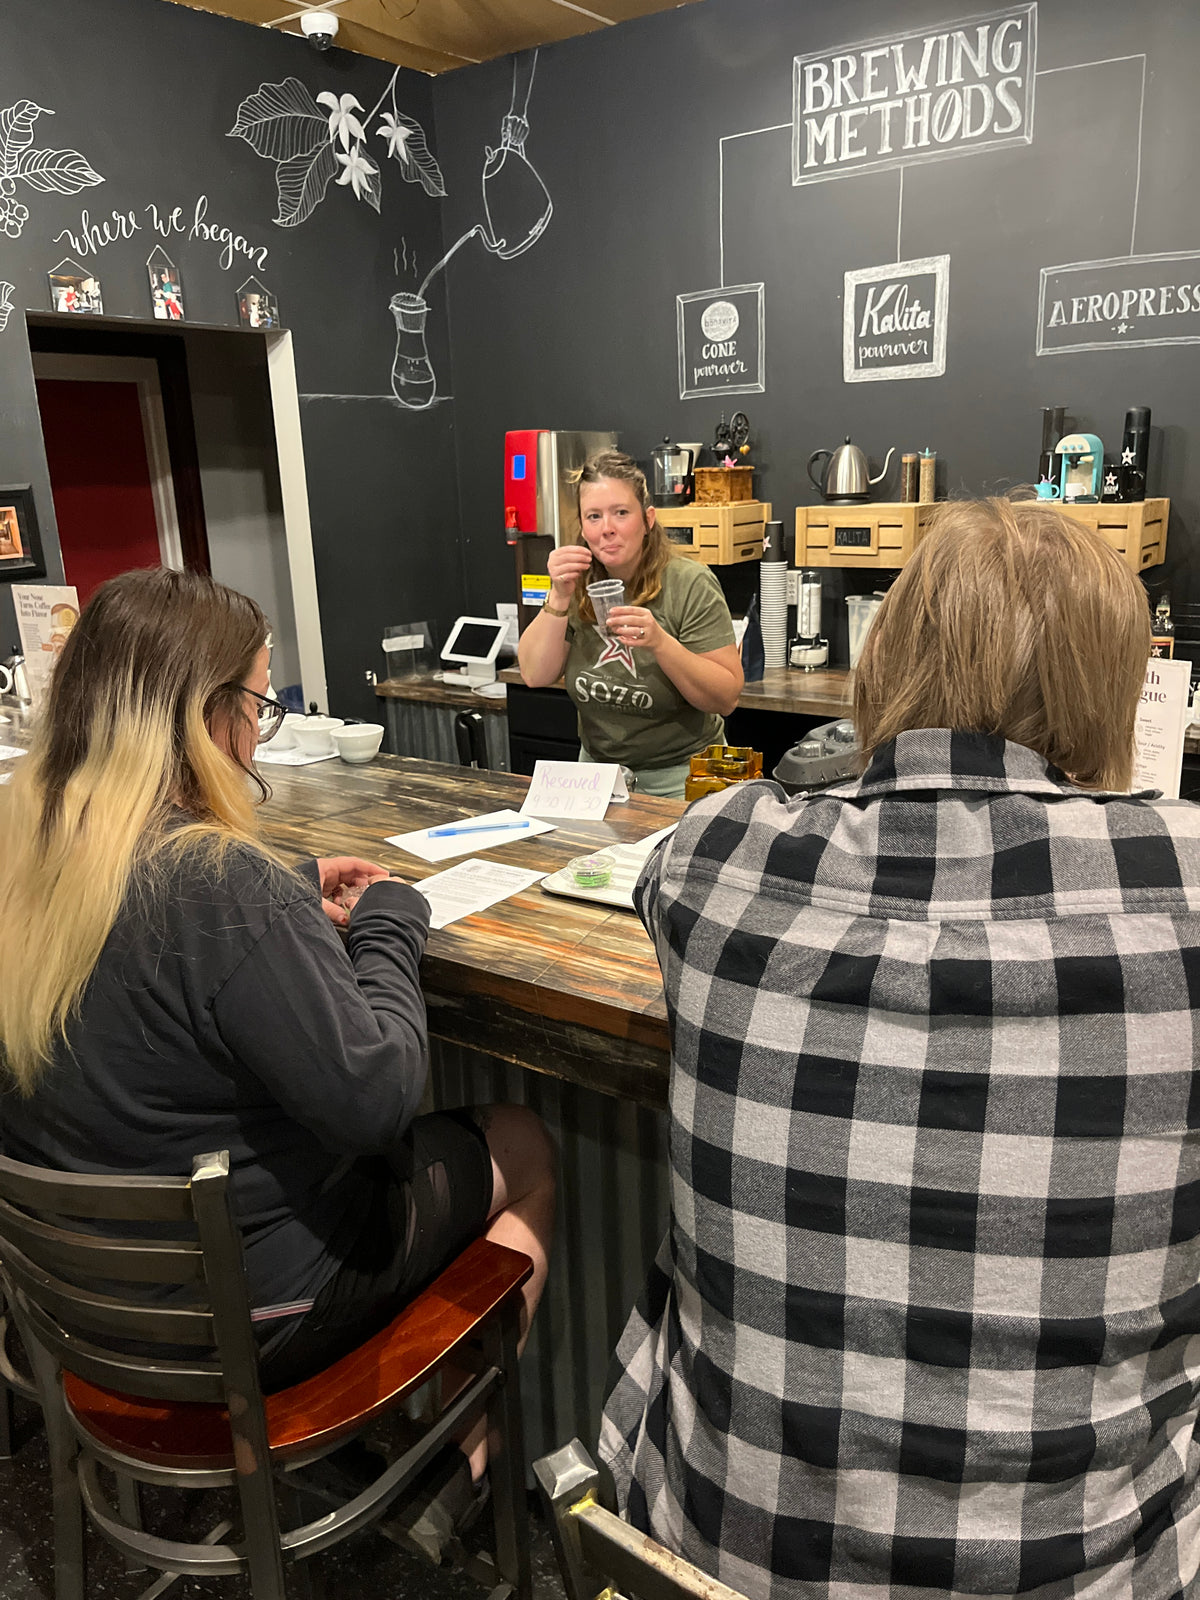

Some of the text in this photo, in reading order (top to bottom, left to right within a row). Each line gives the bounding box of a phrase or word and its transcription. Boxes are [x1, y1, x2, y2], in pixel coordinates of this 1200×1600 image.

[802, 19, 1022, 115] BREWING
[803, 77, 1022, 168] METHODS
[53, 195, 268, 271] where we began
[859, 284, 933, 337] Kalita
[1047, 284, 1200, 328] AEROPRESS
[702, 341, 737, 360] CONE
[858, 338, 929, 367] pourover
[836, 531, 868, 545] KALITA
[575, 676, 653, 710] SOZO
[540, 766, 601, 791] Reserved
